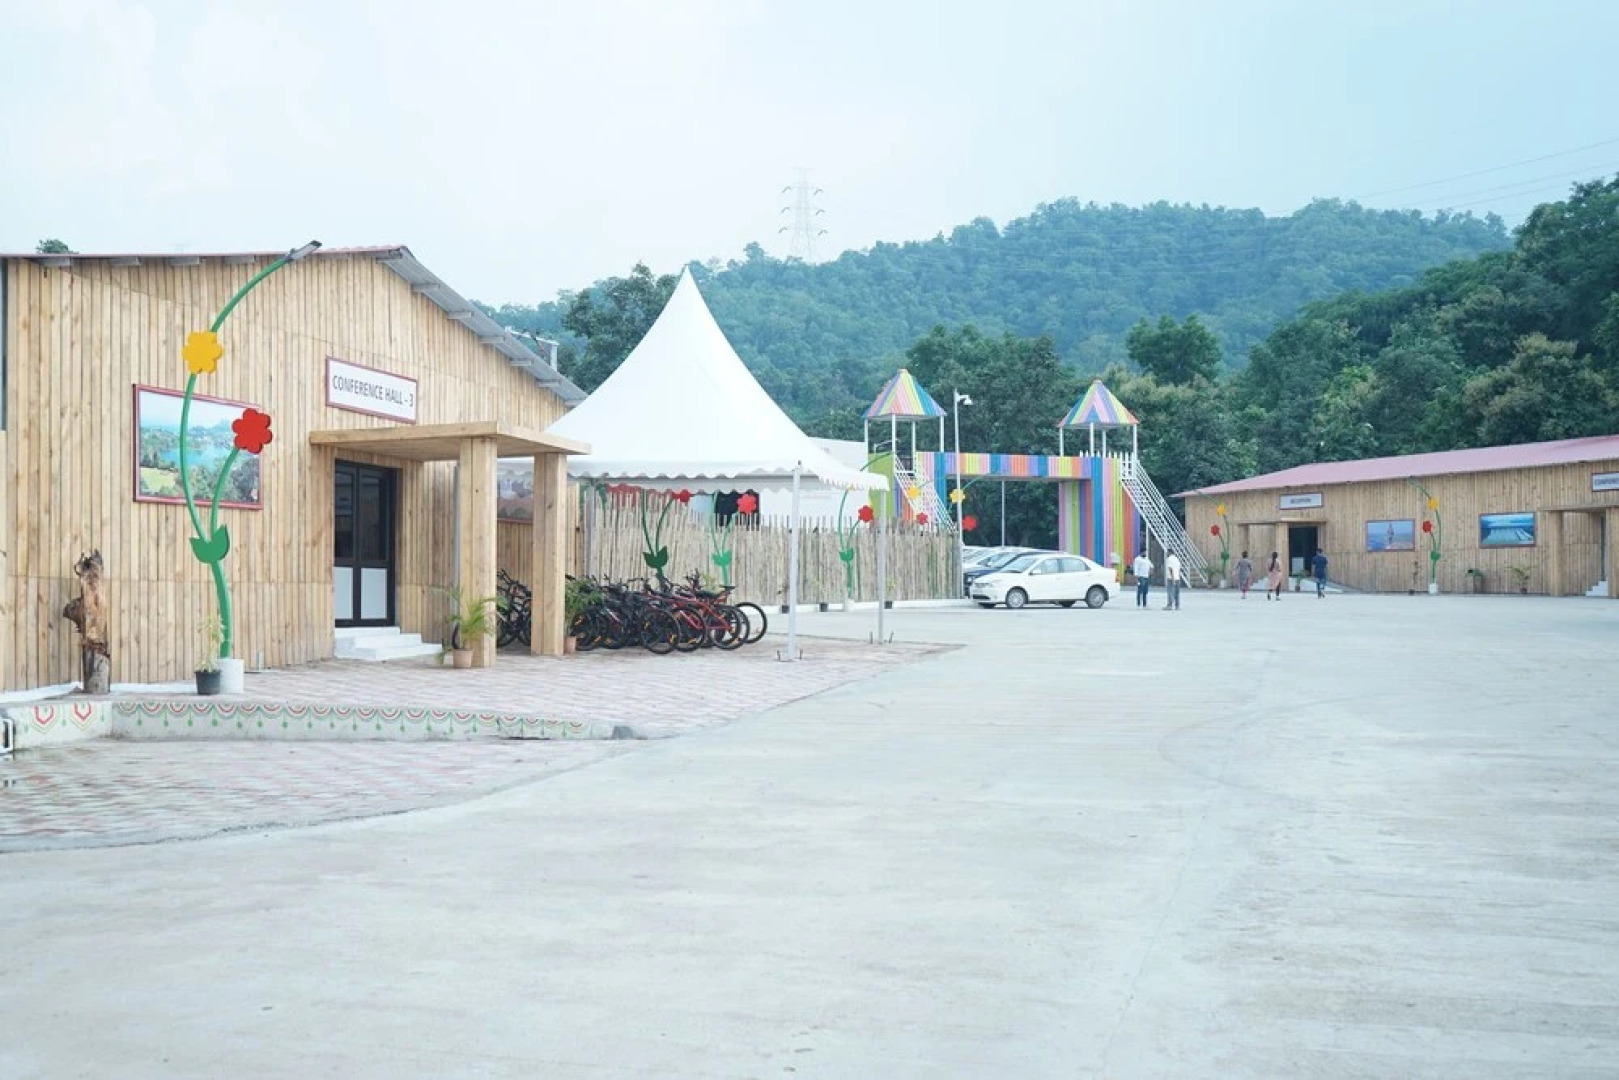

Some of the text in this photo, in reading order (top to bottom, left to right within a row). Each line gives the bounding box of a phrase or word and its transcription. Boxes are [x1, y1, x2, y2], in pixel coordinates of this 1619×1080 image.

[332, 375, 383, 400] CONFERENCE
[385, 387, 403, 405] HALL
[409, 393, 414, 407] 3
